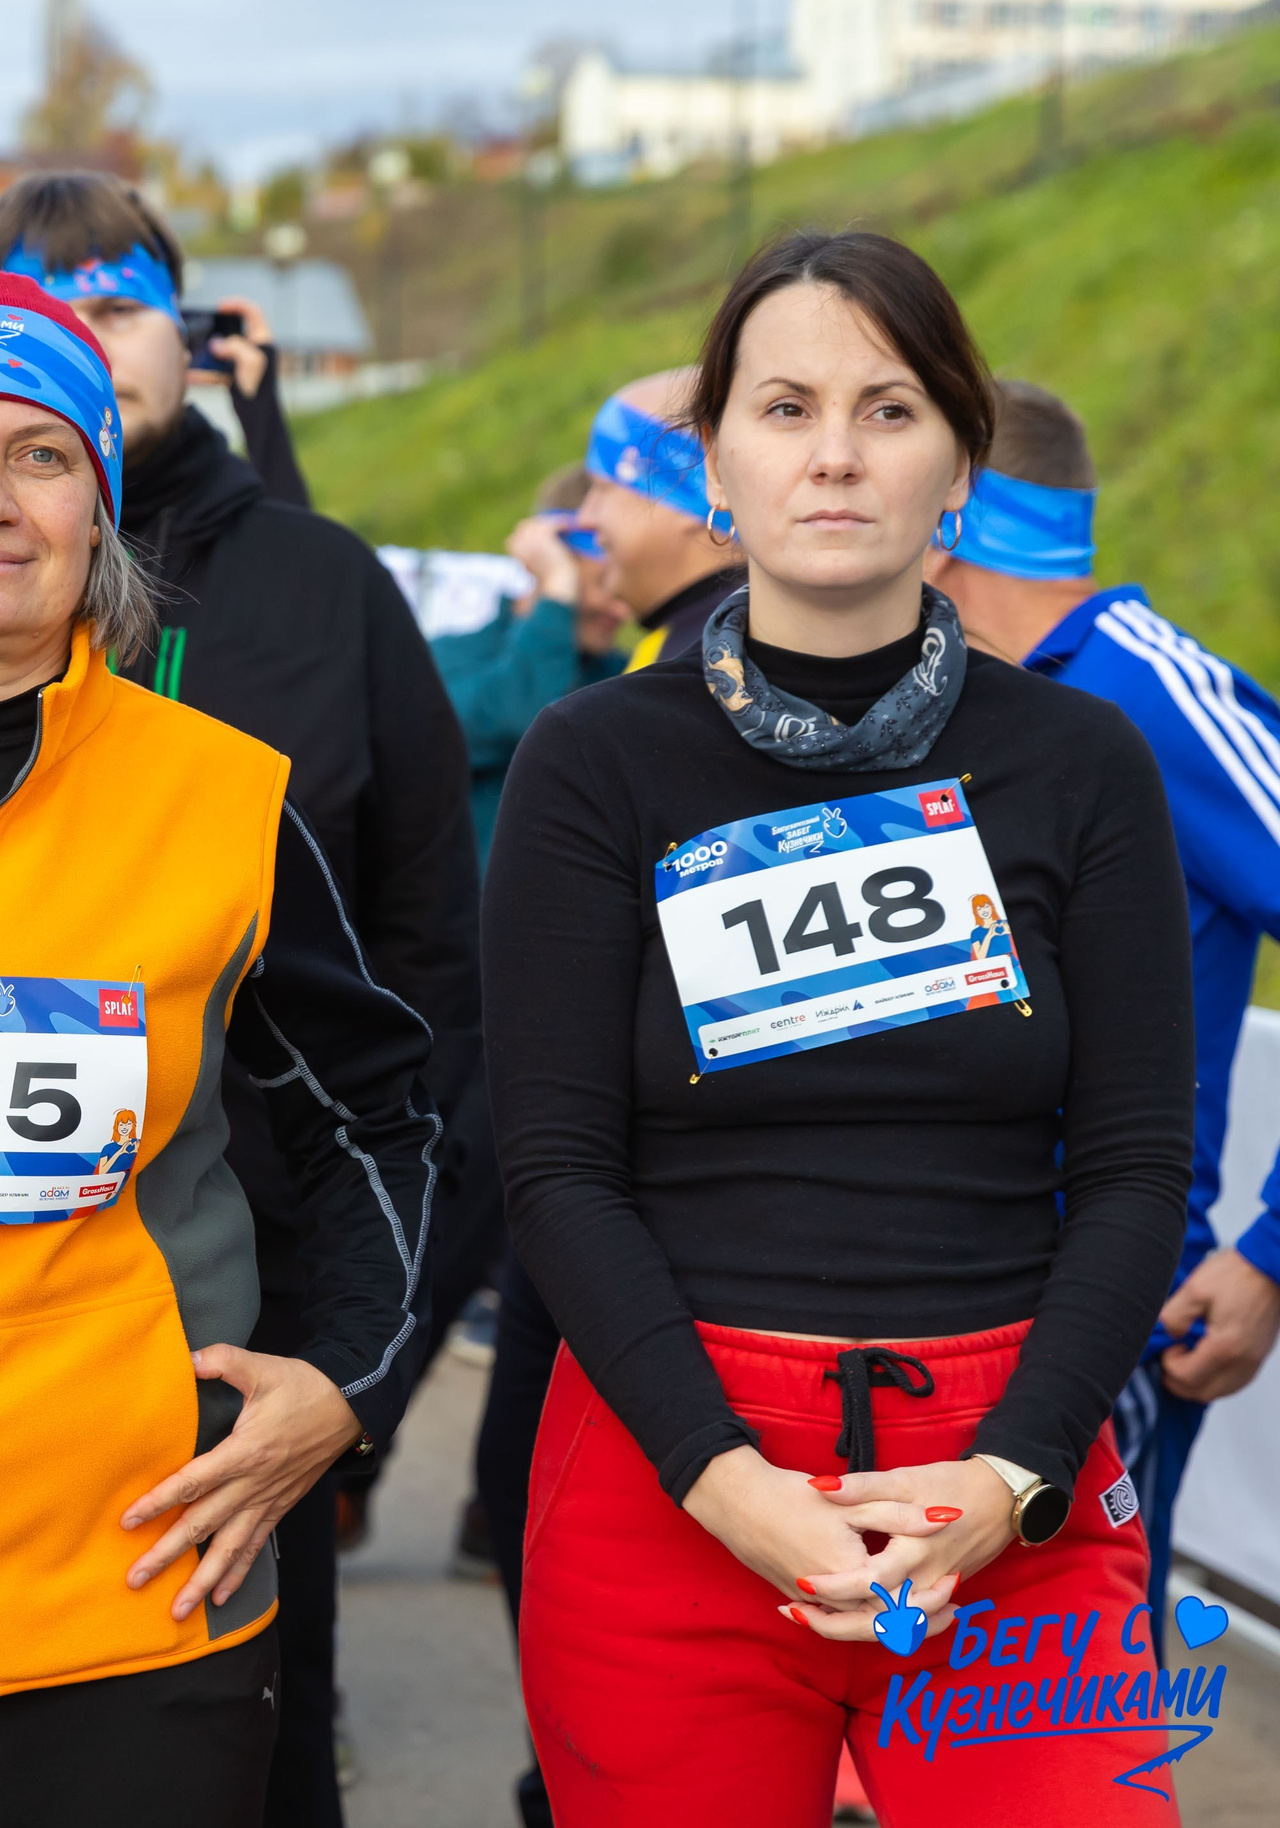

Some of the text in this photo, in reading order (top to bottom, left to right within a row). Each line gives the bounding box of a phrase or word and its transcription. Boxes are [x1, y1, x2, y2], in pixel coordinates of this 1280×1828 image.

[786, 826, 811, 838] ЗАБЕГ
[778, 832, 824, 854] Кузнечики
[672, 840, 728, 872] 1000
[679, 858, 724, 878] метров
[721, 866, 945, 975] 148
[770, 1014, 806, 1029] centre
[82, 1185, 115, 1196] GrossHaus
